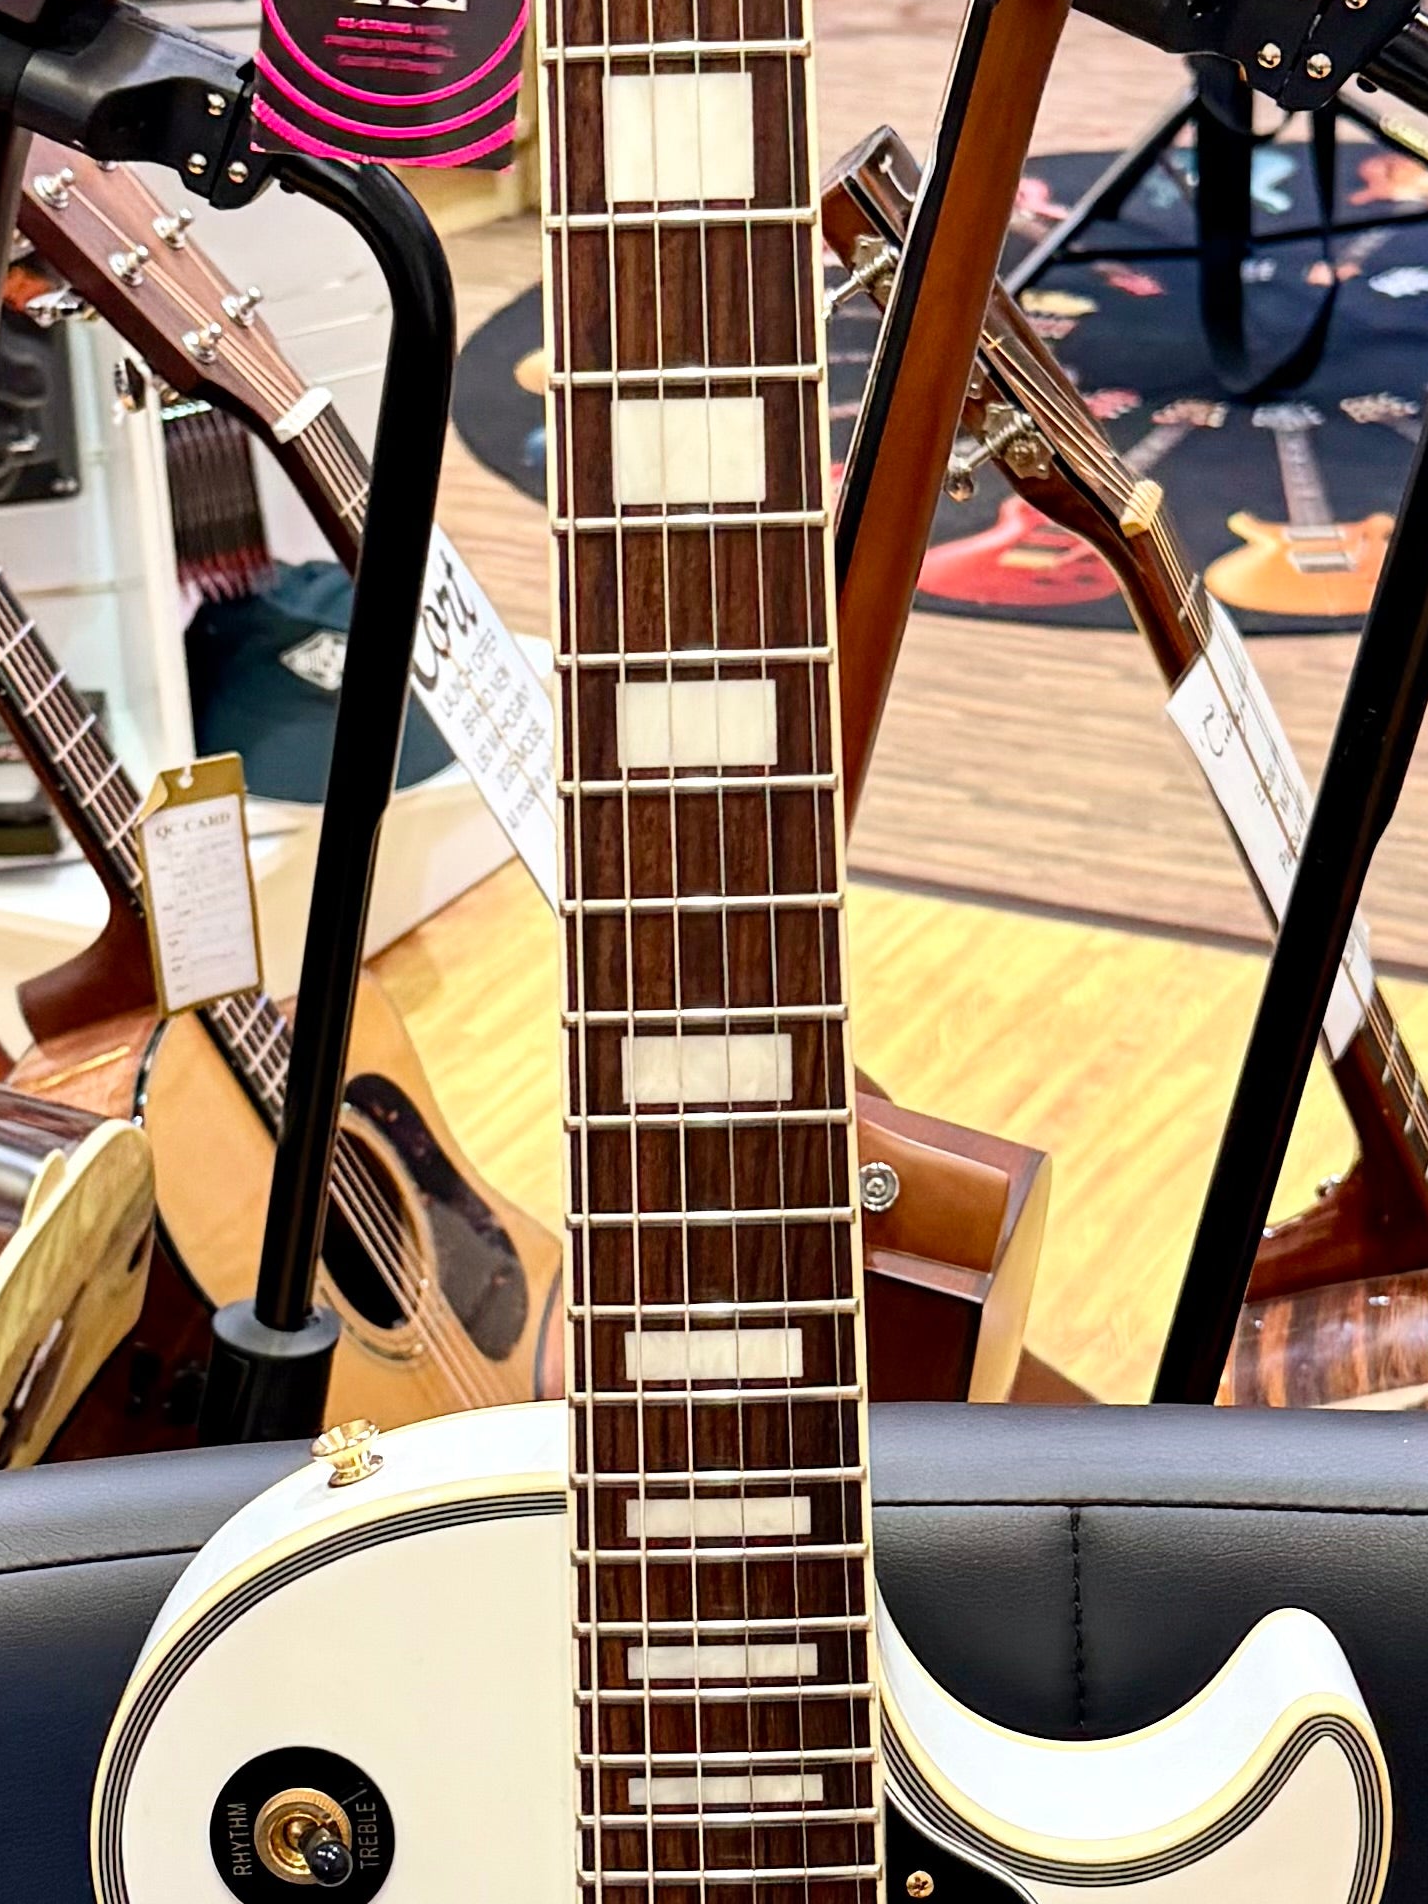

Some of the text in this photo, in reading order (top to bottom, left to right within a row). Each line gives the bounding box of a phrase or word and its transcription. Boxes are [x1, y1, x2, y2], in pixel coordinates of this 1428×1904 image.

[182, 811, 231, 833] CARD
[227, 1802, 254, 1877] RHYTHM
[356, 1801, 382, 1870] TREBLE
